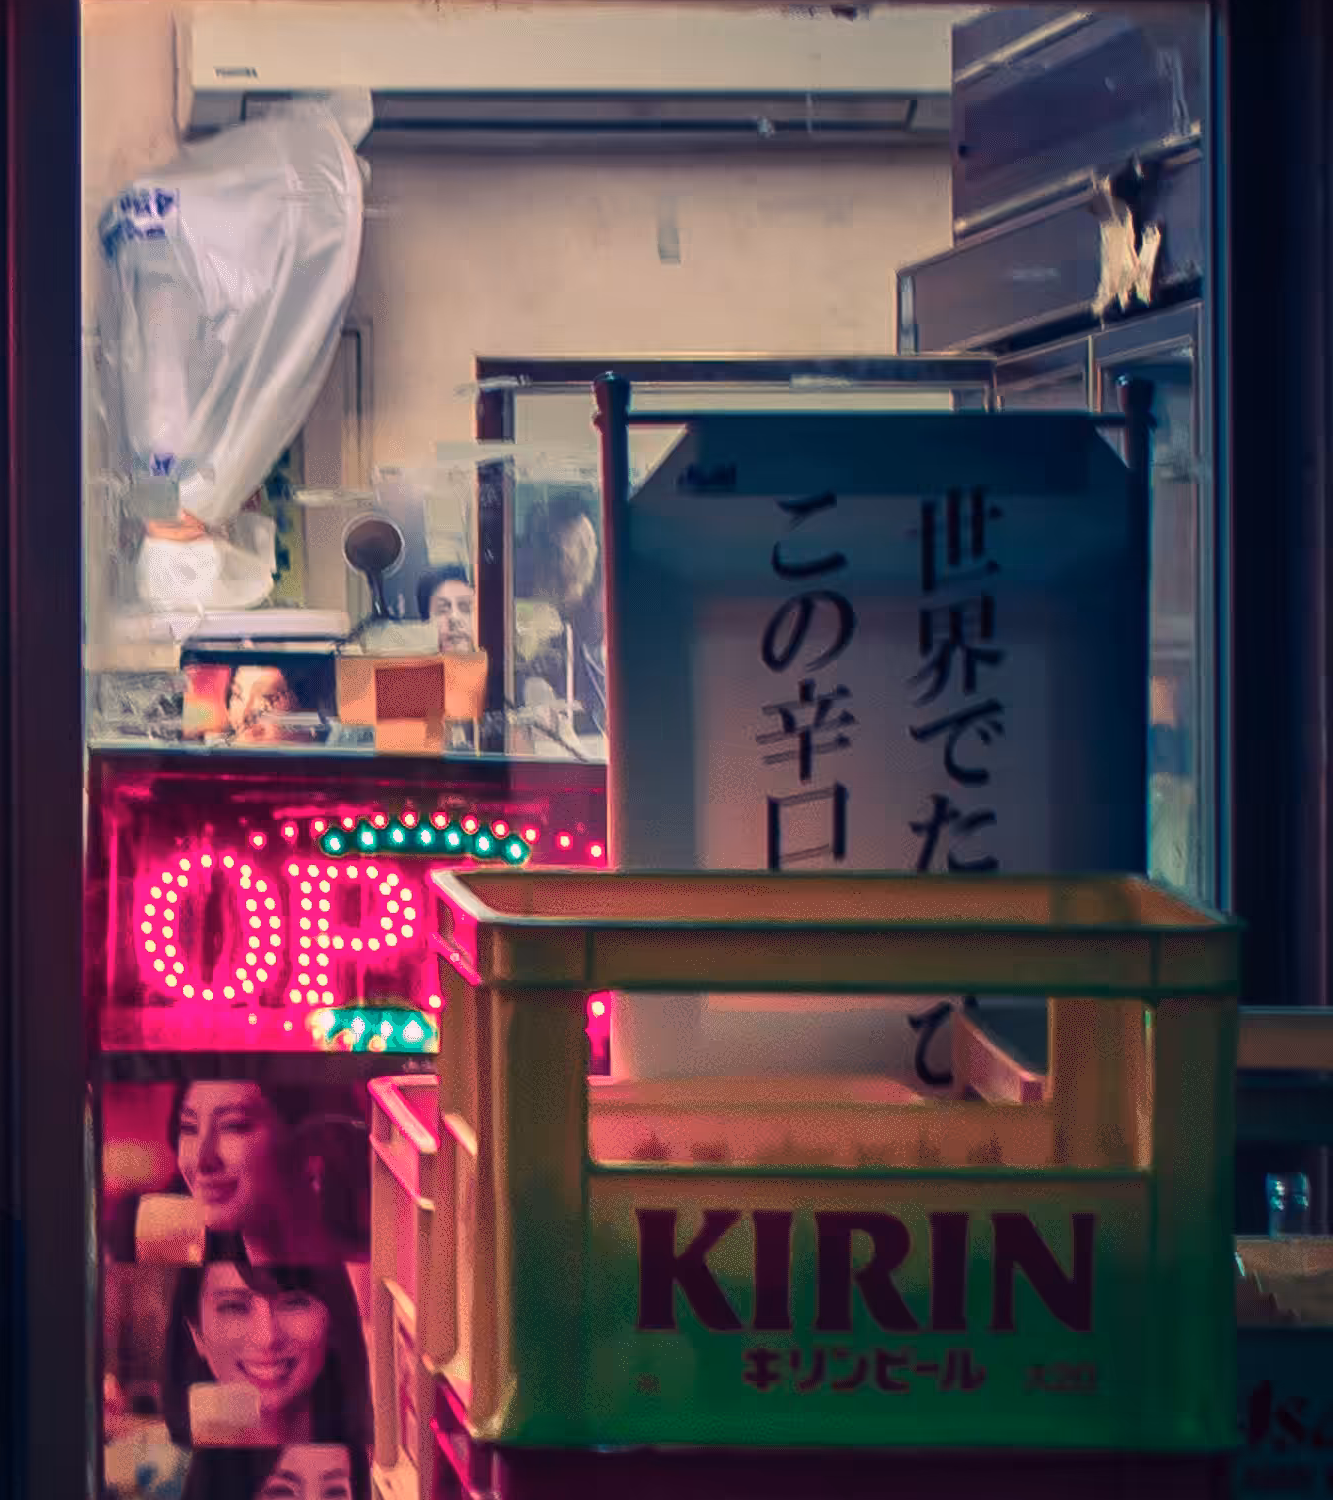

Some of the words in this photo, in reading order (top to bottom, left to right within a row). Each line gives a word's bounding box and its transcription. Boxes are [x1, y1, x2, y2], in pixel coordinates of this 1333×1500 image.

[754, 490, 858, 874] この辛口
[633, 1207, 1097, 1336] KIRIN
[740, 1346, 989, 1395] キリンビール
